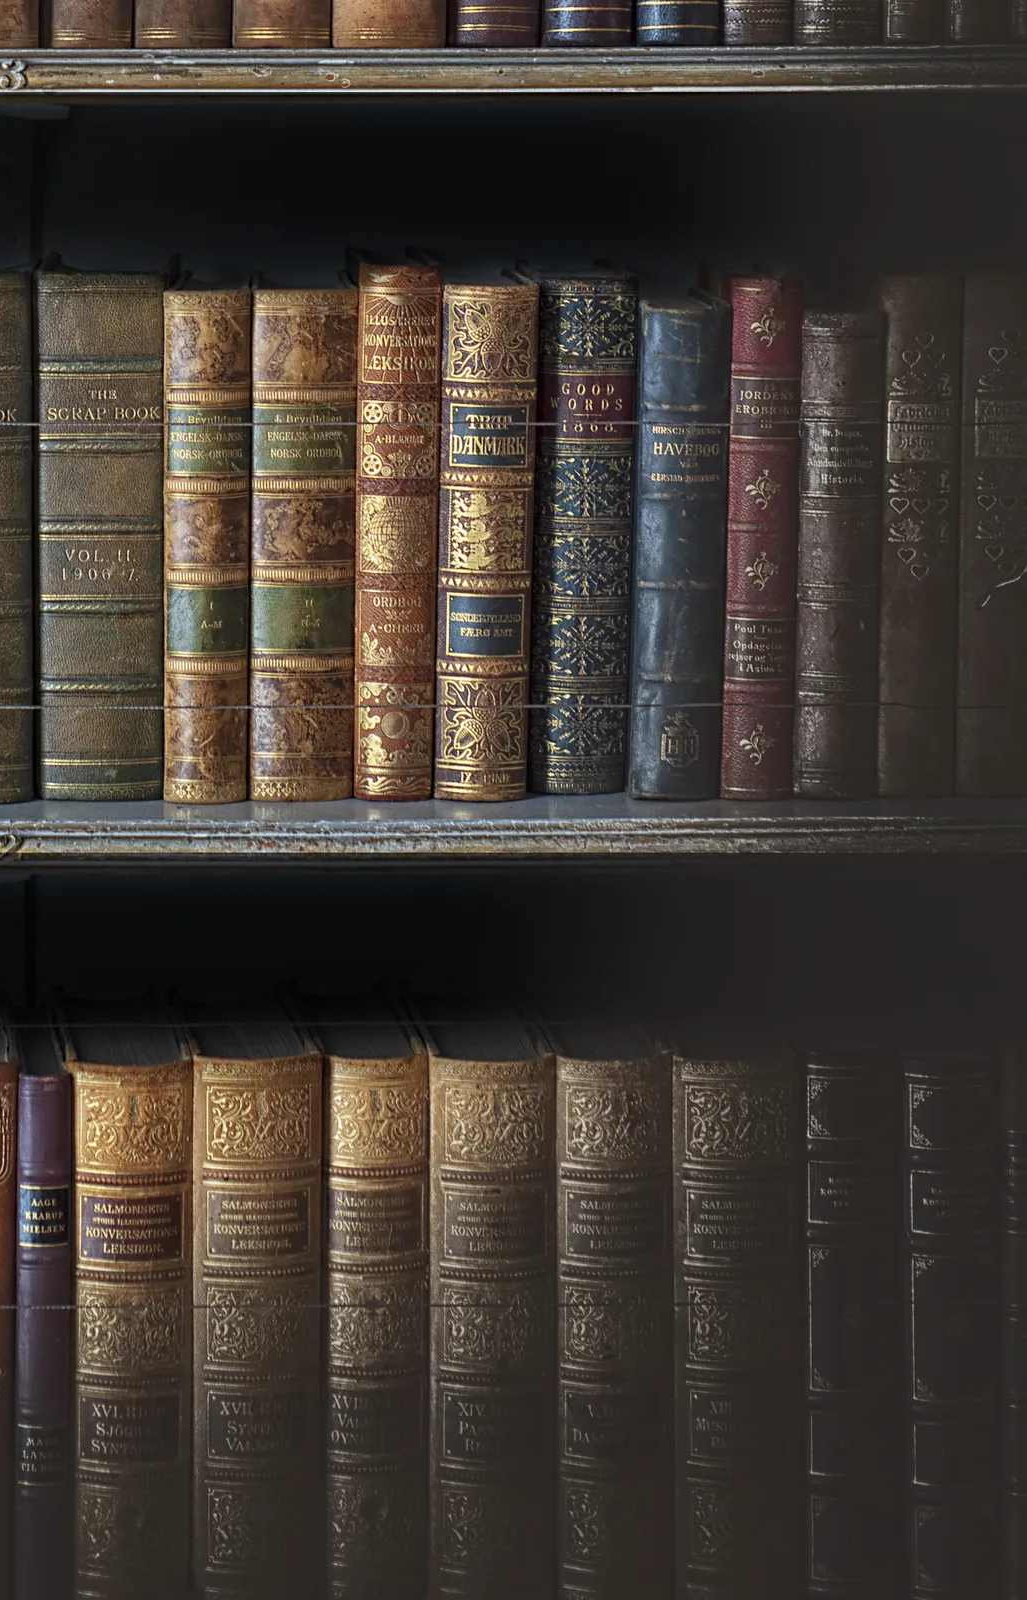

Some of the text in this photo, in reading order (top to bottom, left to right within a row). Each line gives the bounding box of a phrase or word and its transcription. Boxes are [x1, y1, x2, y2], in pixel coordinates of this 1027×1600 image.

[365, 357, 435, 370] LEKSIKON
[88, 390, 117, 399] THE
[562, 383, 614, 395] GOOD
[740, 390, 794, 401] JORDENS
[551, 398, 622, 410] WORDS
[47, 406, 160, 420] SCRAP BOOK
[453, 437, 524, 455] DANMARK
[654, 443, 719, 455] HAVEBOG
[451, 612, 520, 623] SØNDERJYLLAND
[494, 628, 513, 637] AMT
[31, 1199, 56, 1207] AAGE
[25, 1211, 63, 1220] KRARUP
[23, 1225, 65, 1233] NIELSEN
[86, 1226, 178, 1239] KONVERSATIONS
